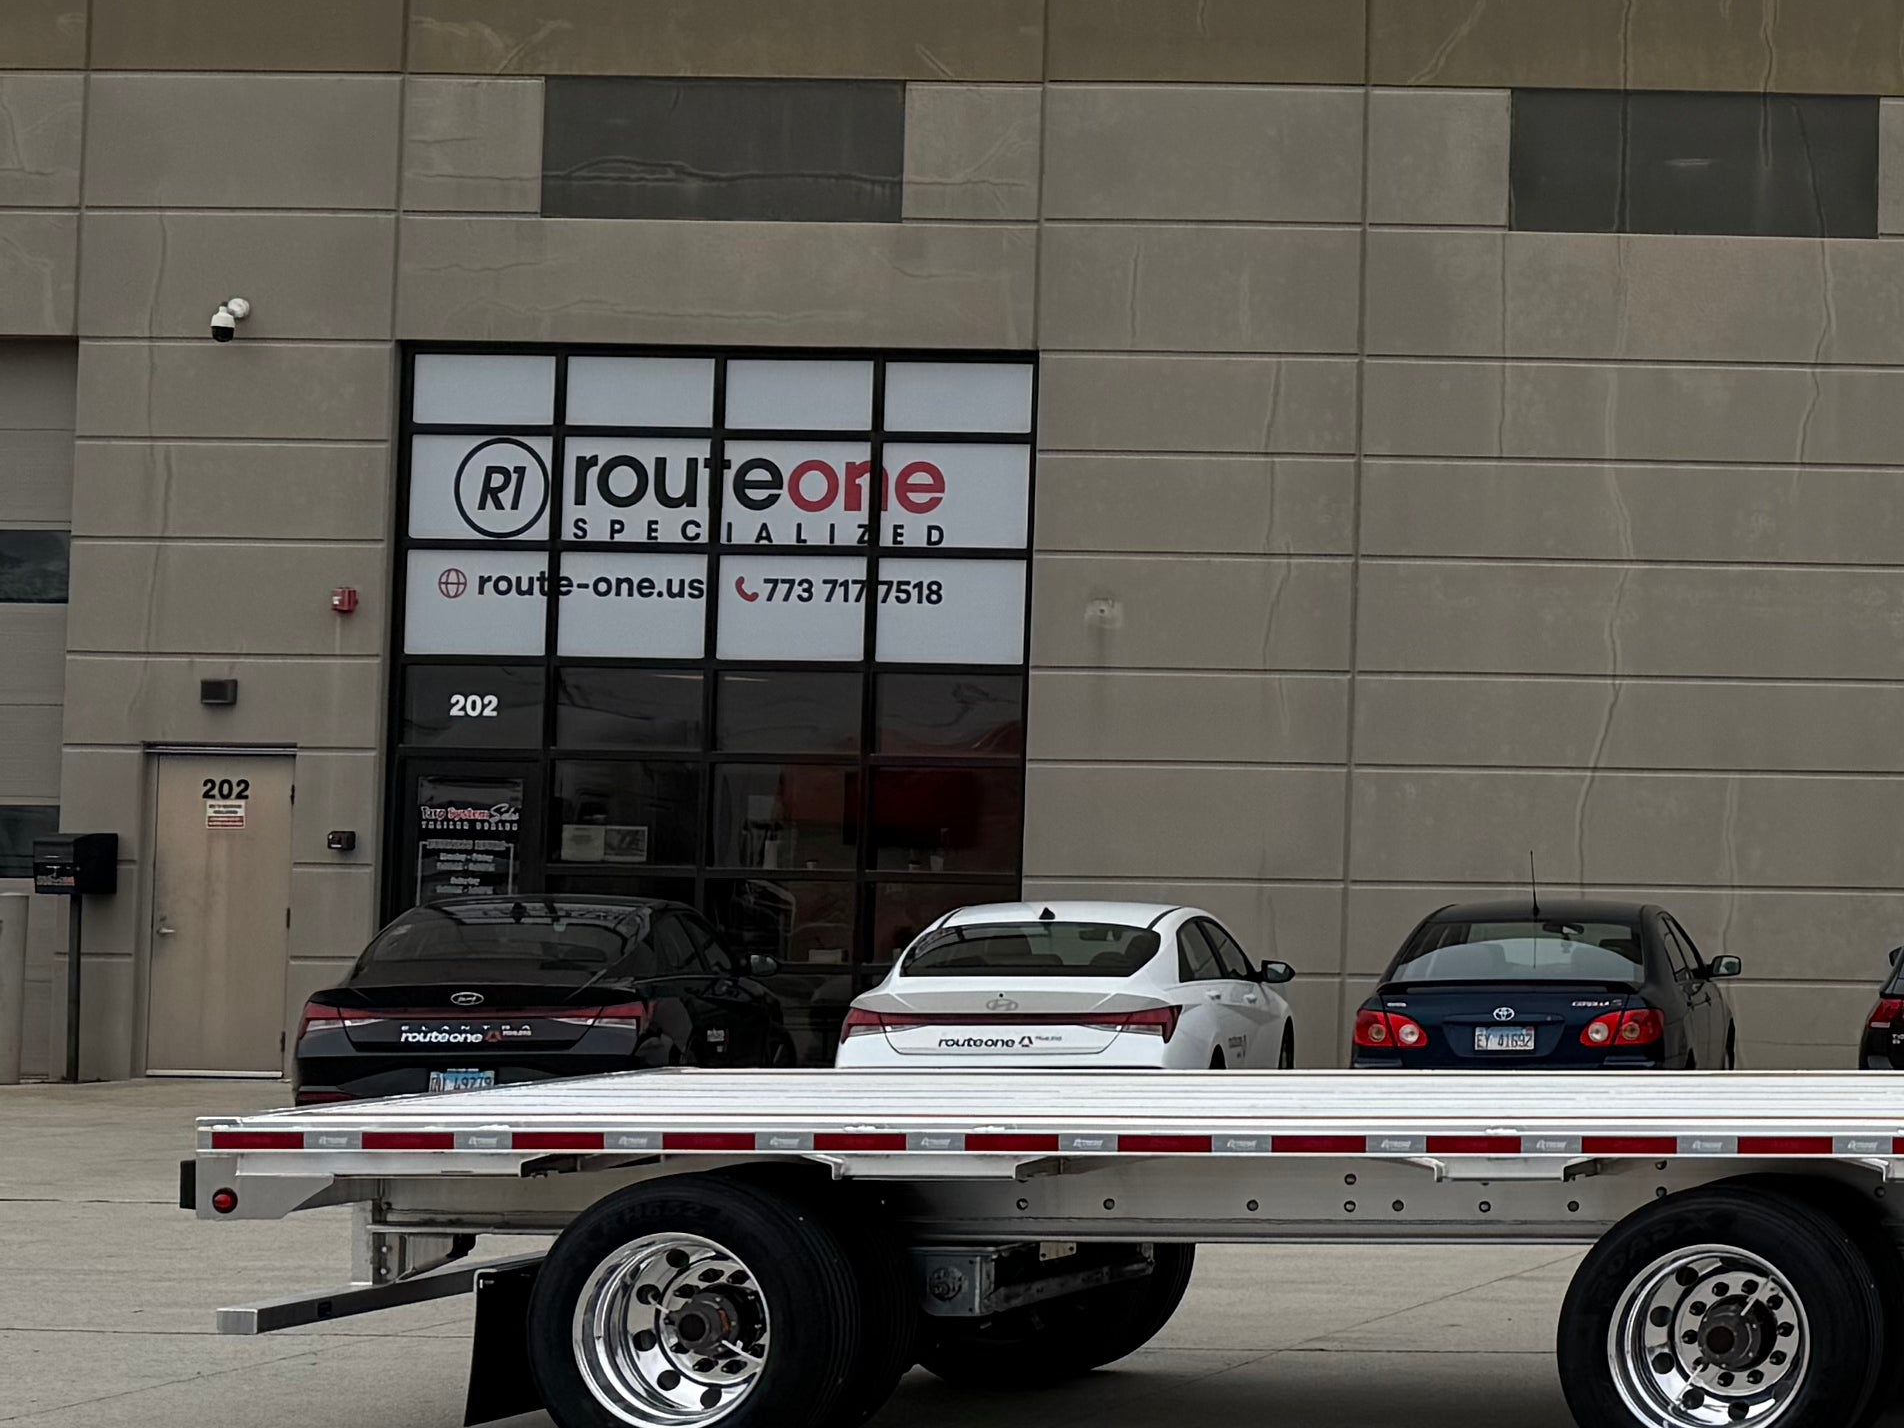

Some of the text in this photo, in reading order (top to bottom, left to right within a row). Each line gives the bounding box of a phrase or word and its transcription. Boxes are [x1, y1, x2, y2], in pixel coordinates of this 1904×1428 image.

[477, 465, 528, 510] R1
[573, 517, 945, 547] SPECIALIZED
[477, 571, 705, 600] route-one.us
[763, 578, 944, 605] 773 717 7518
[449, 694, 498, 717] 202
[202, 778, 250, 800] 202
[400, 1031, 483, 1043] routeone
[938, 1037, 1016, 1048] routeone
